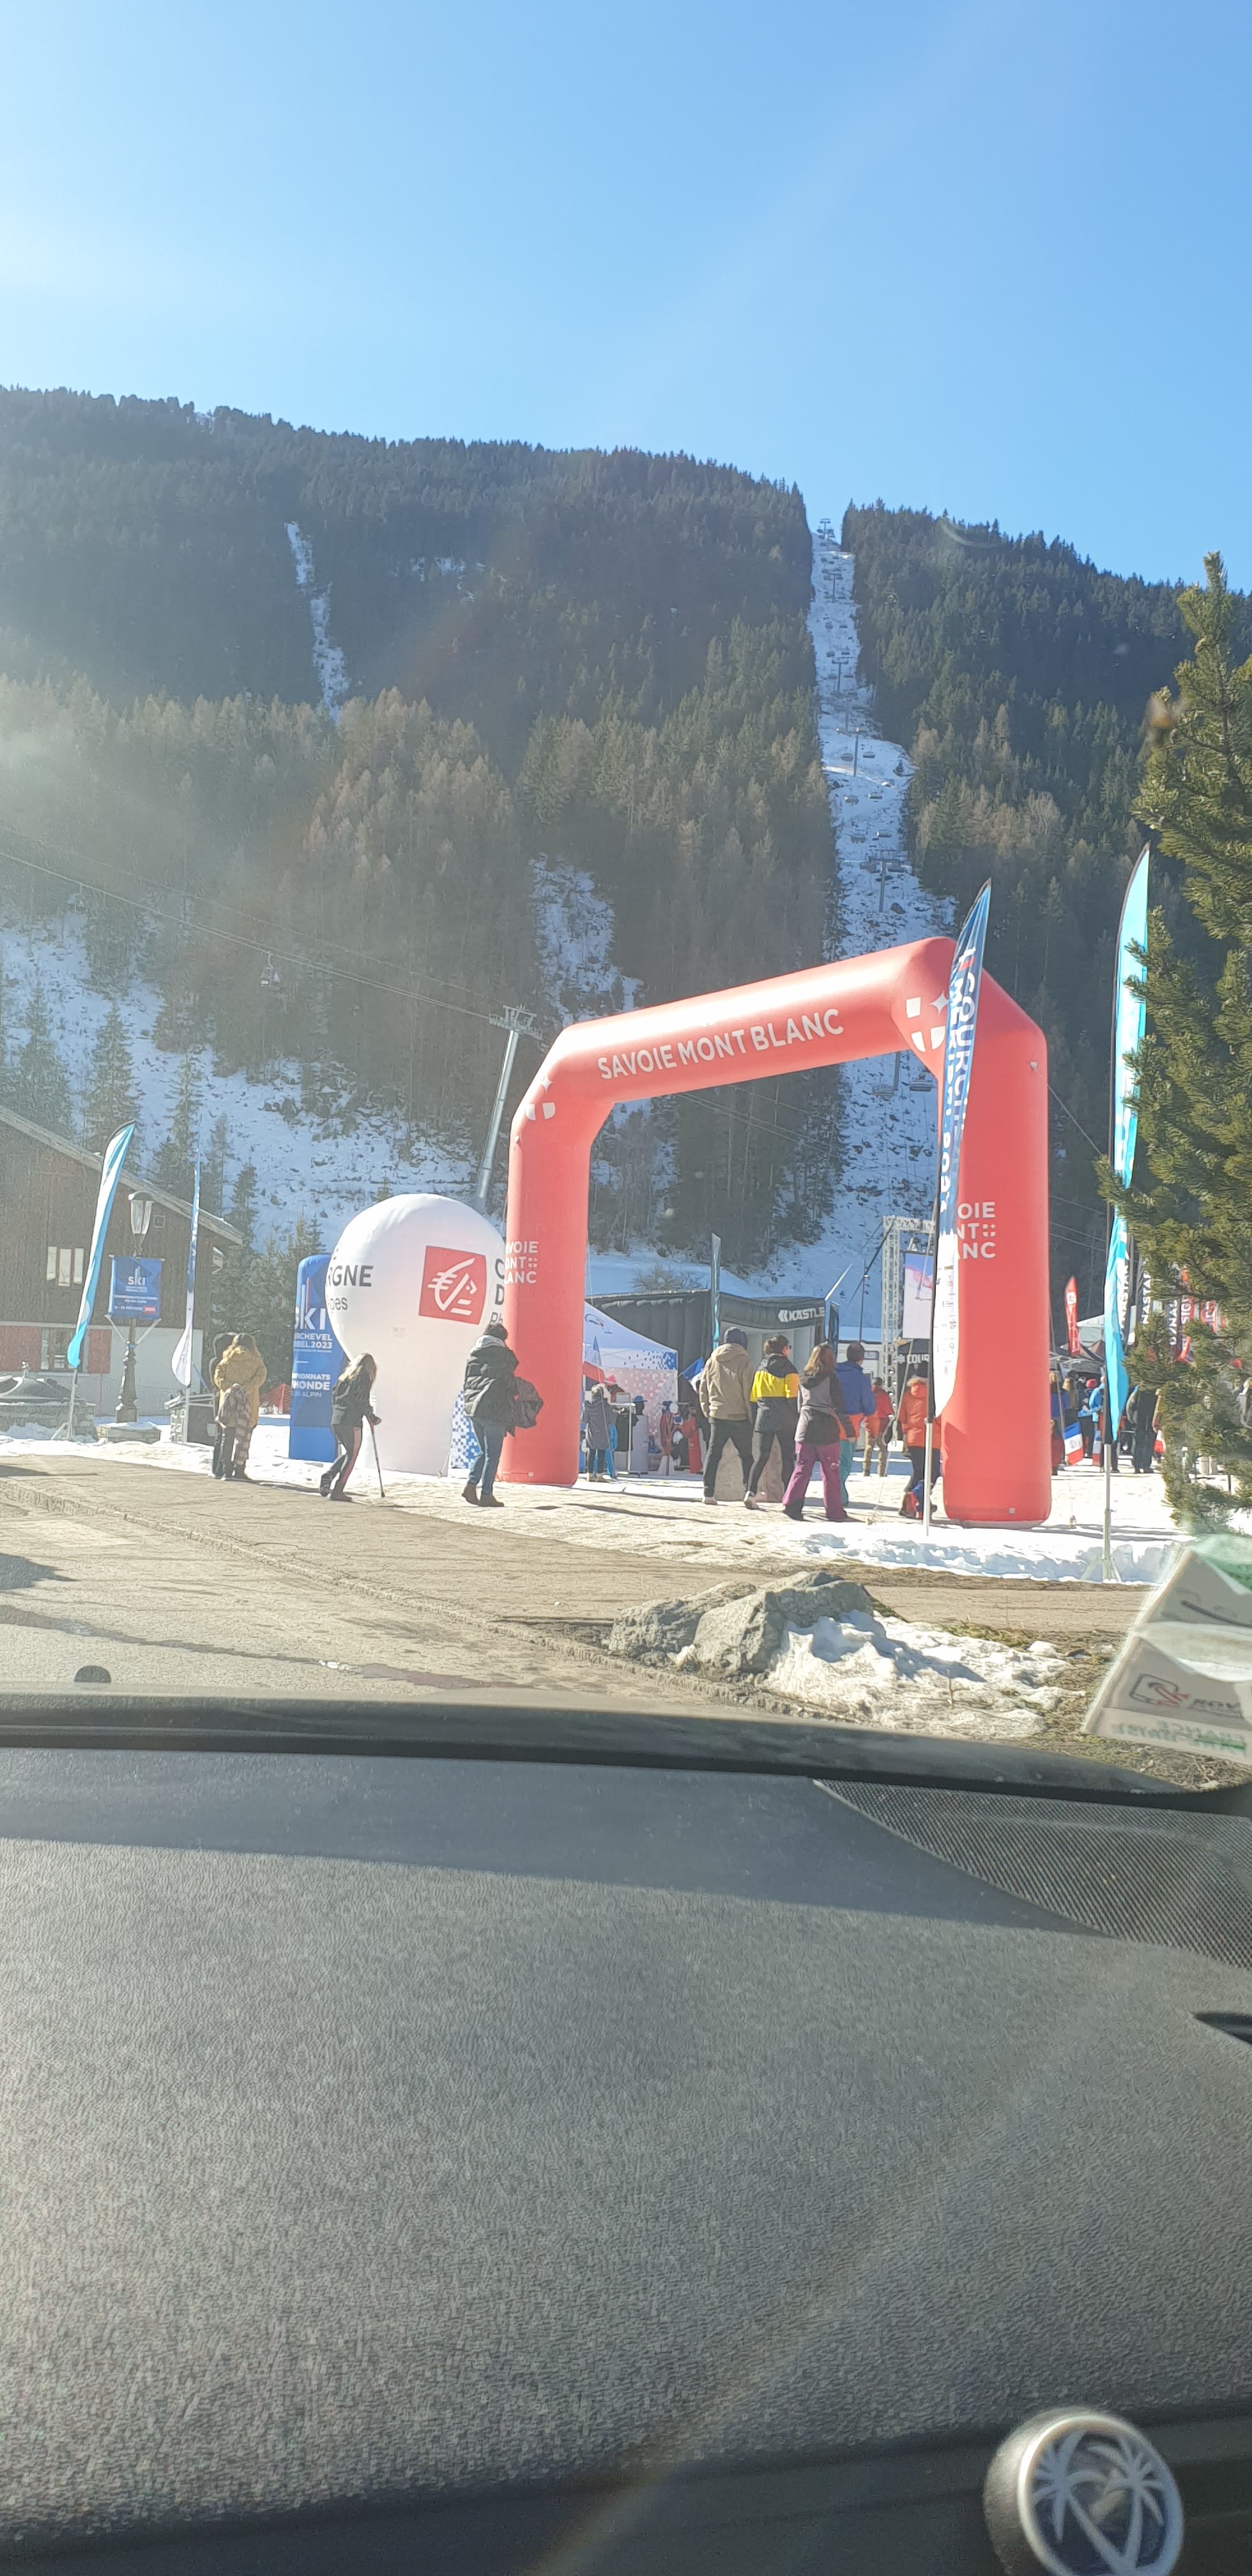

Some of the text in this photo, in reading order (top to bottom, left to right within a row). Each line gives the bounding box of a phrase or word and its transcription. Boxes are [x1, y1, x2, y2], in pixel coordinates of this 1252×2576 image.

[597, 1008, 844, 1079] SAVOIE MONT BLANC
[957, 1201, 996, 1219] OIE
[956, 1222, 980, 1239] NT
